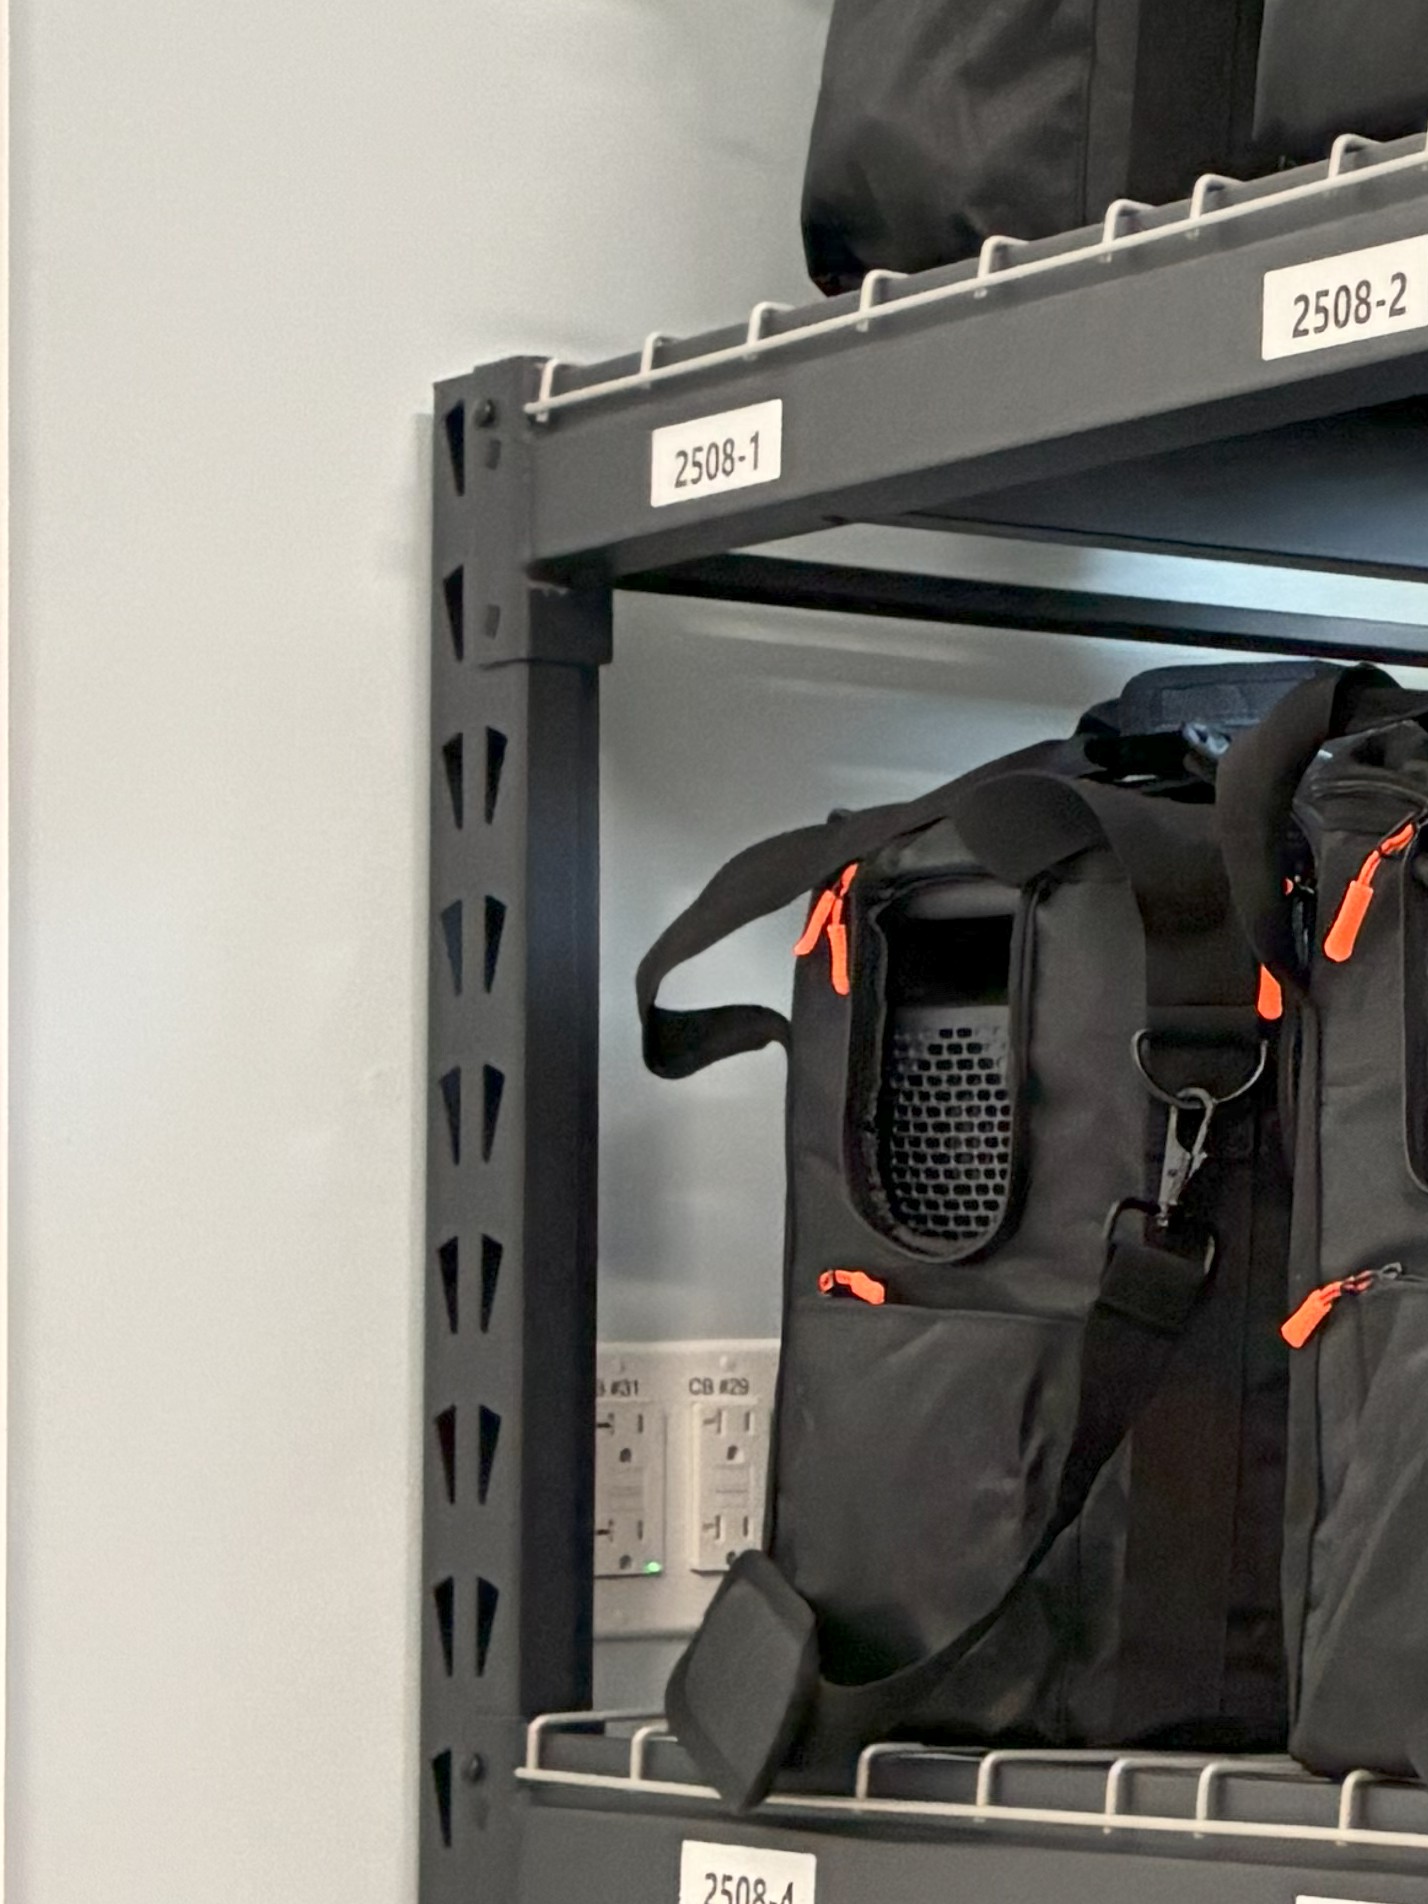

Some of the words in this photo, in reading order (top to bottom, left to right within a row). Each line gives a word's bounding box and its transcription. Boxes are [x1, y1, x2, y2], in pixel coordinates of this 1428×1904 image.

[1291, 271, 1408, 339] 2508-2
[674, 430, 760, 488] 2508-1
[688, 1376, 714, 1396] CB
[719, 1376, 750, 1396] #29
